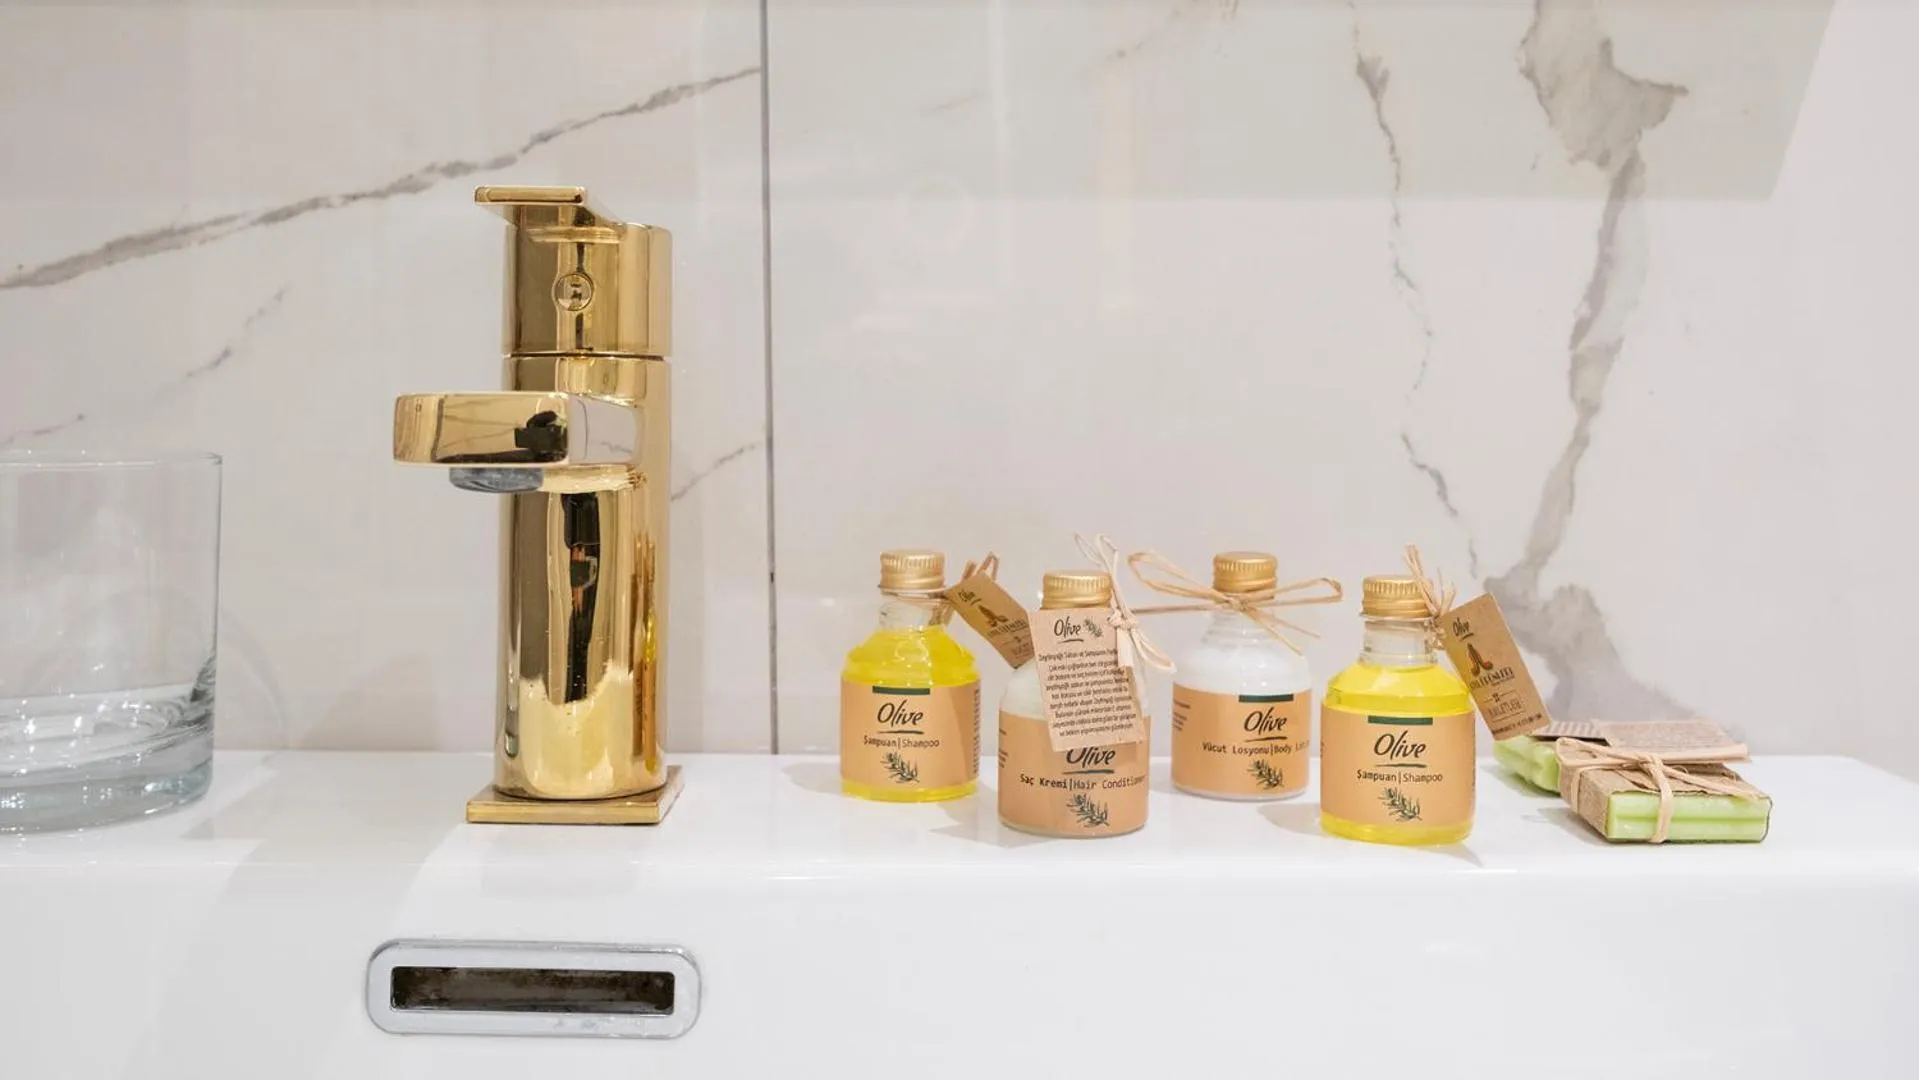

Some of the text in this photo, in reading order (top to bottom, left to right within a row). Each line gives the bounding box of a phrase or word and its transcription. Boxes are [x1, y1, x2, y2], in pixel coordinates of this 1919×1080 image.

[1053, 616, 1082, 638] Olive
[877, 699, 924, 727] Olive
[1244, 706, 1288, 735] Olive
[1201, 740, 1228, 755] Vücut
[1373, 730, 1427, 760] Olive
[1066, 747, 1116, 768] Olive
[1020, 773, 1035, 787] Saç
